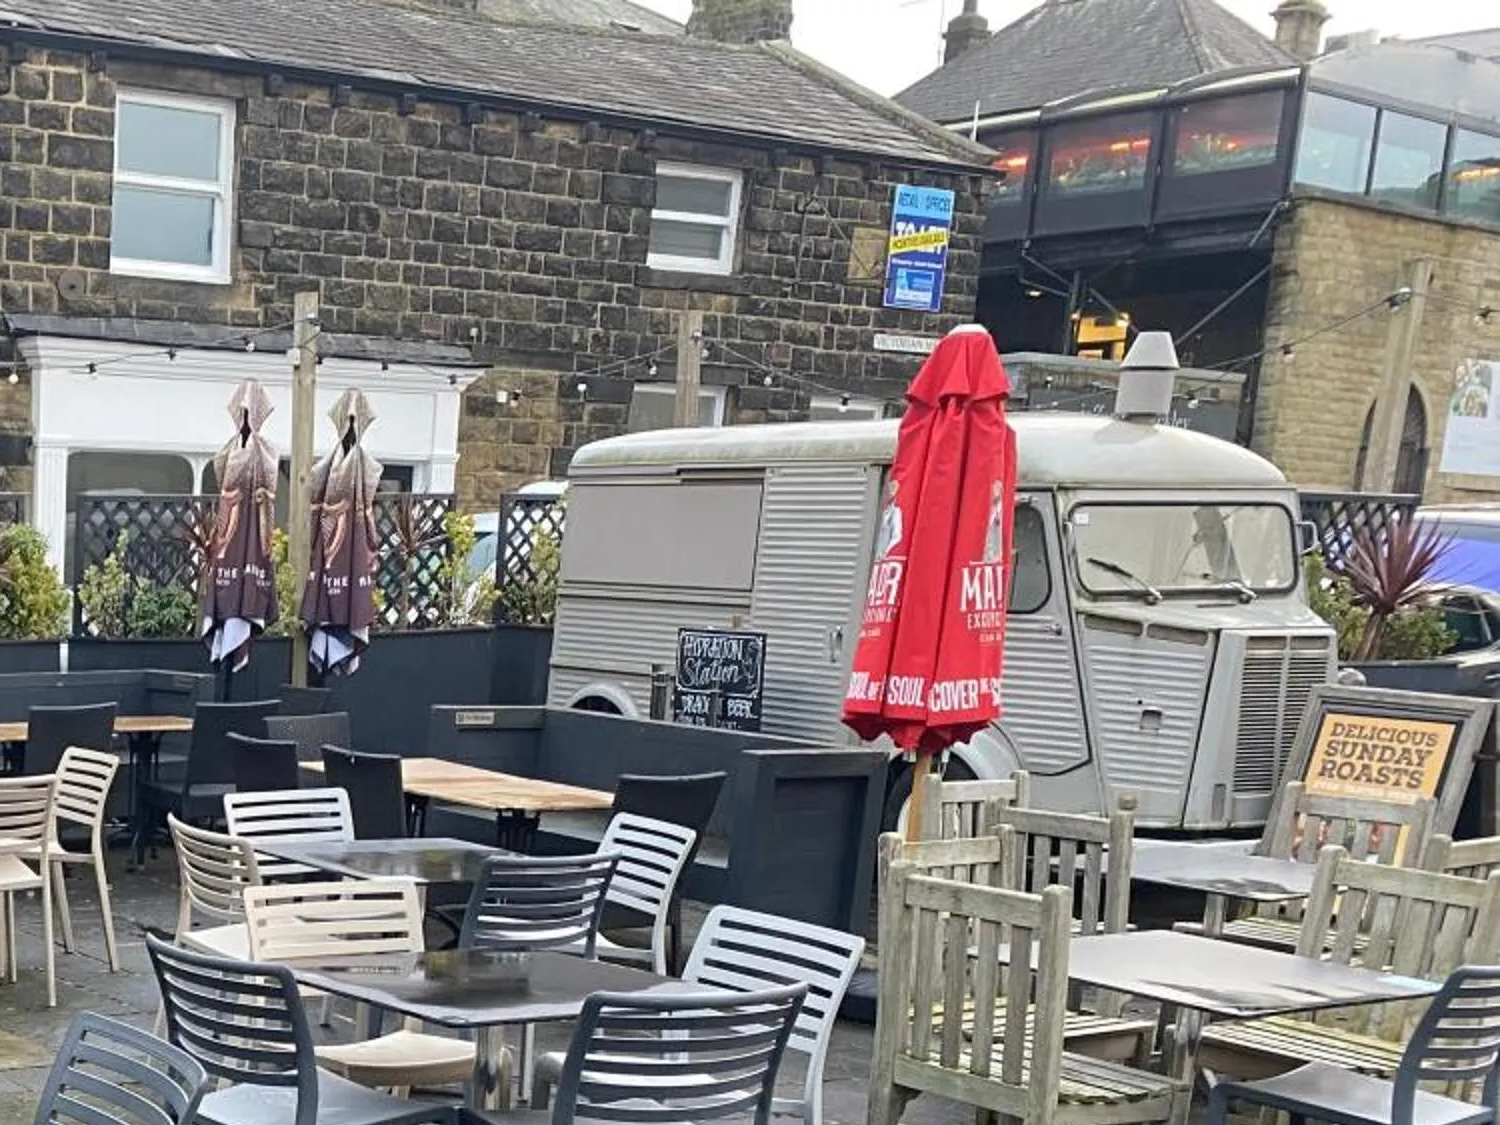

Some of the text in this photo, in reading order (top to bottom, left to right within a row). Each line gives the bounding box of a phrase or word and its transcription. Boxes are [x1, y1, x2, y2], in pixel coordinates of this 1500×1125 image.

[681, 657, 743, 687] Station
[886, 675, 925, 706] SOUL
[1330, 722, 1439, 747] DELICIOUS
[1324, 739, 1433, 768] SUNDAY
[1318, 758, 1425, 789] ROASTS
